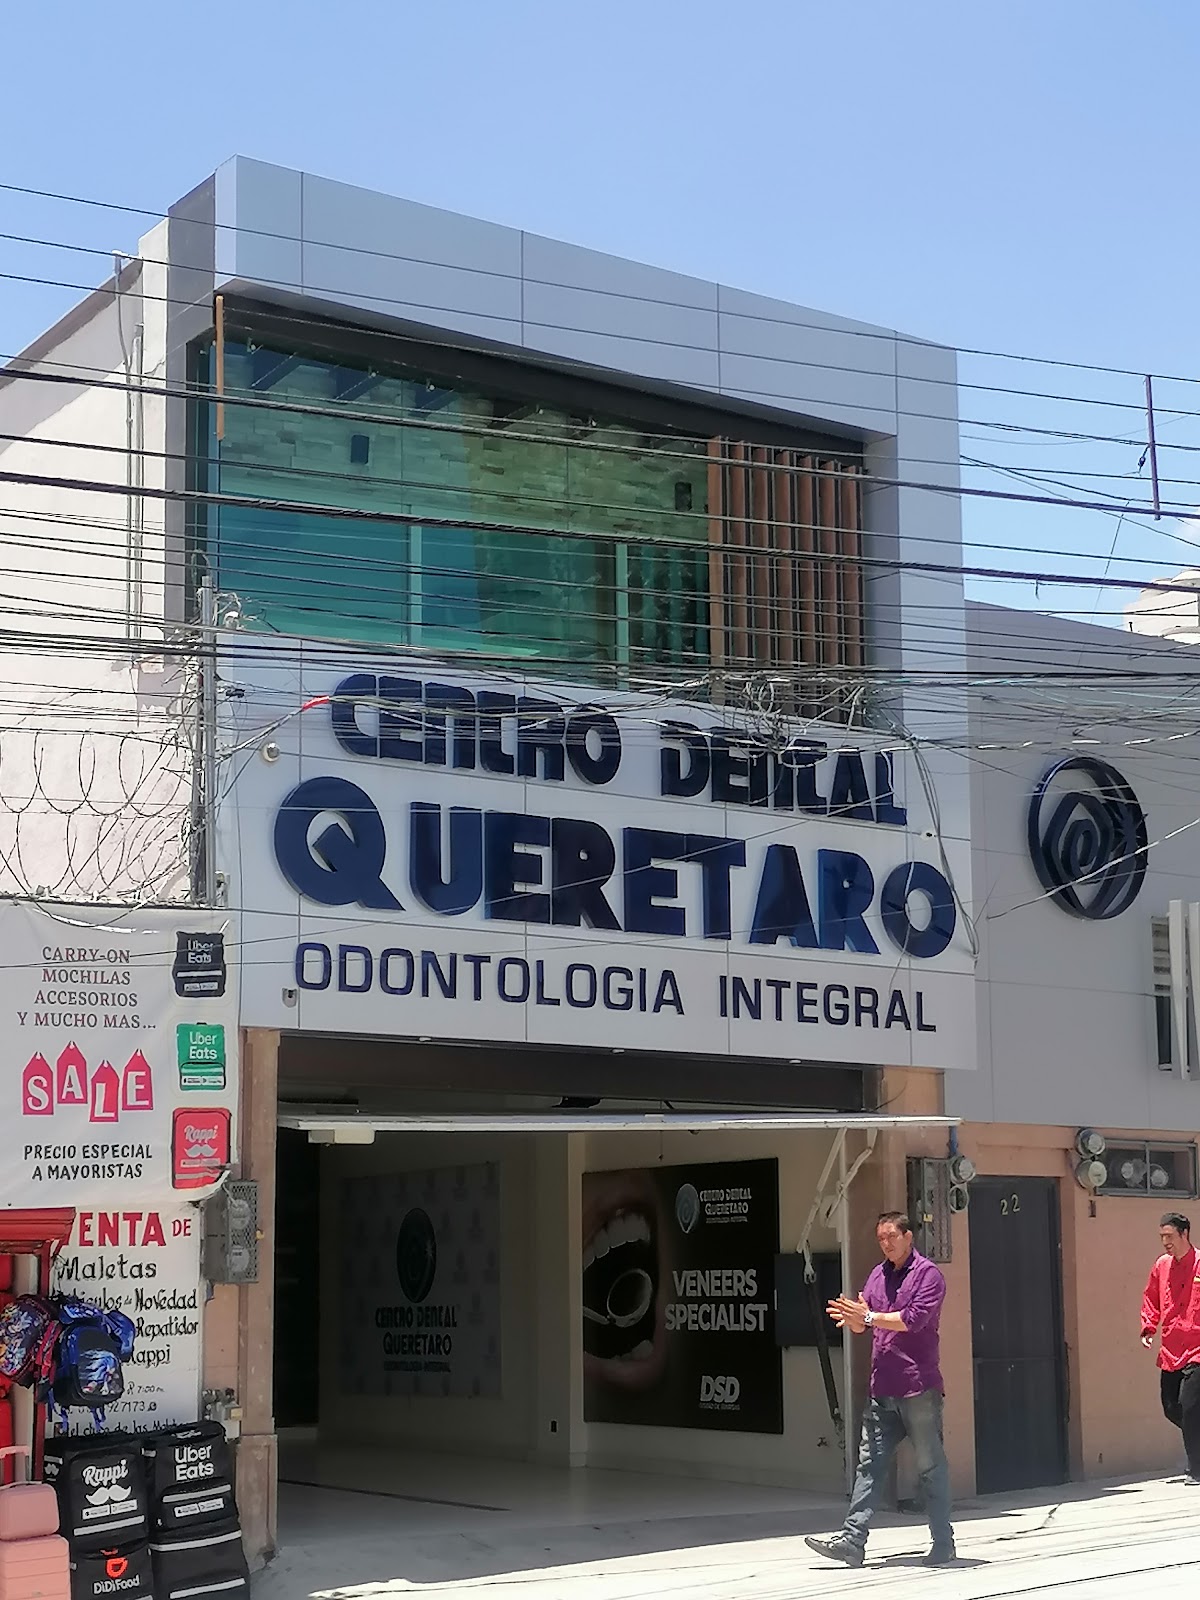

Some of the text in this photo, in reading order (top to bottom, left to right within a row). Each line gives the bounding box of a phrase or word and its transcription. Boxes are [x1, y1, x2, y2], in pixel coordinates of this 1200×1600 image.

[274, 775, 957, 959] QUERETARO
[42, 946, 131, 964] CARRY-ON
[187, 939, 214, 952] Uber
[187, 952, 212, 964] Eats
[42, 968, 131, 985] MOCHILAS
[295, 942, 937, 1033] ODONTOLOGIA INTEGRAL
[34, 989, 138, 1007] ACCESORIOS
[17, 1012, 28, 1026] Y
[34, 1012, 98, 1028] MUCHO
[189, 1031, 217, 1045] Uber
[188, 1045, 218, 1060] Eats
[27, 1063, 150, 1118] SALE
[184, 1124, 219, 1145] Rappi
[24, 1143, 153, 1160] PRECIO ESPECIAL
[32, 1163, 143, 1180] A MAYORISTAS
[1000, 1193, 1021, 1216] 22
[172, 1218, 192, 1237] DE
[58, 1253, 158, 1281] Maletas
[672, 1269, 758, 1297] VENEERS
[664, 1303, 768, 1332] SPECIALIST
[383, 1331, 452, 1356] QUERETARO
[700, 1375, 740, 1403] DSD
[174, 1445, 212, 1463] Uber
[82, 1459, 129, 1487] Rappi
[175, 1461, 215, 1481] Eats
